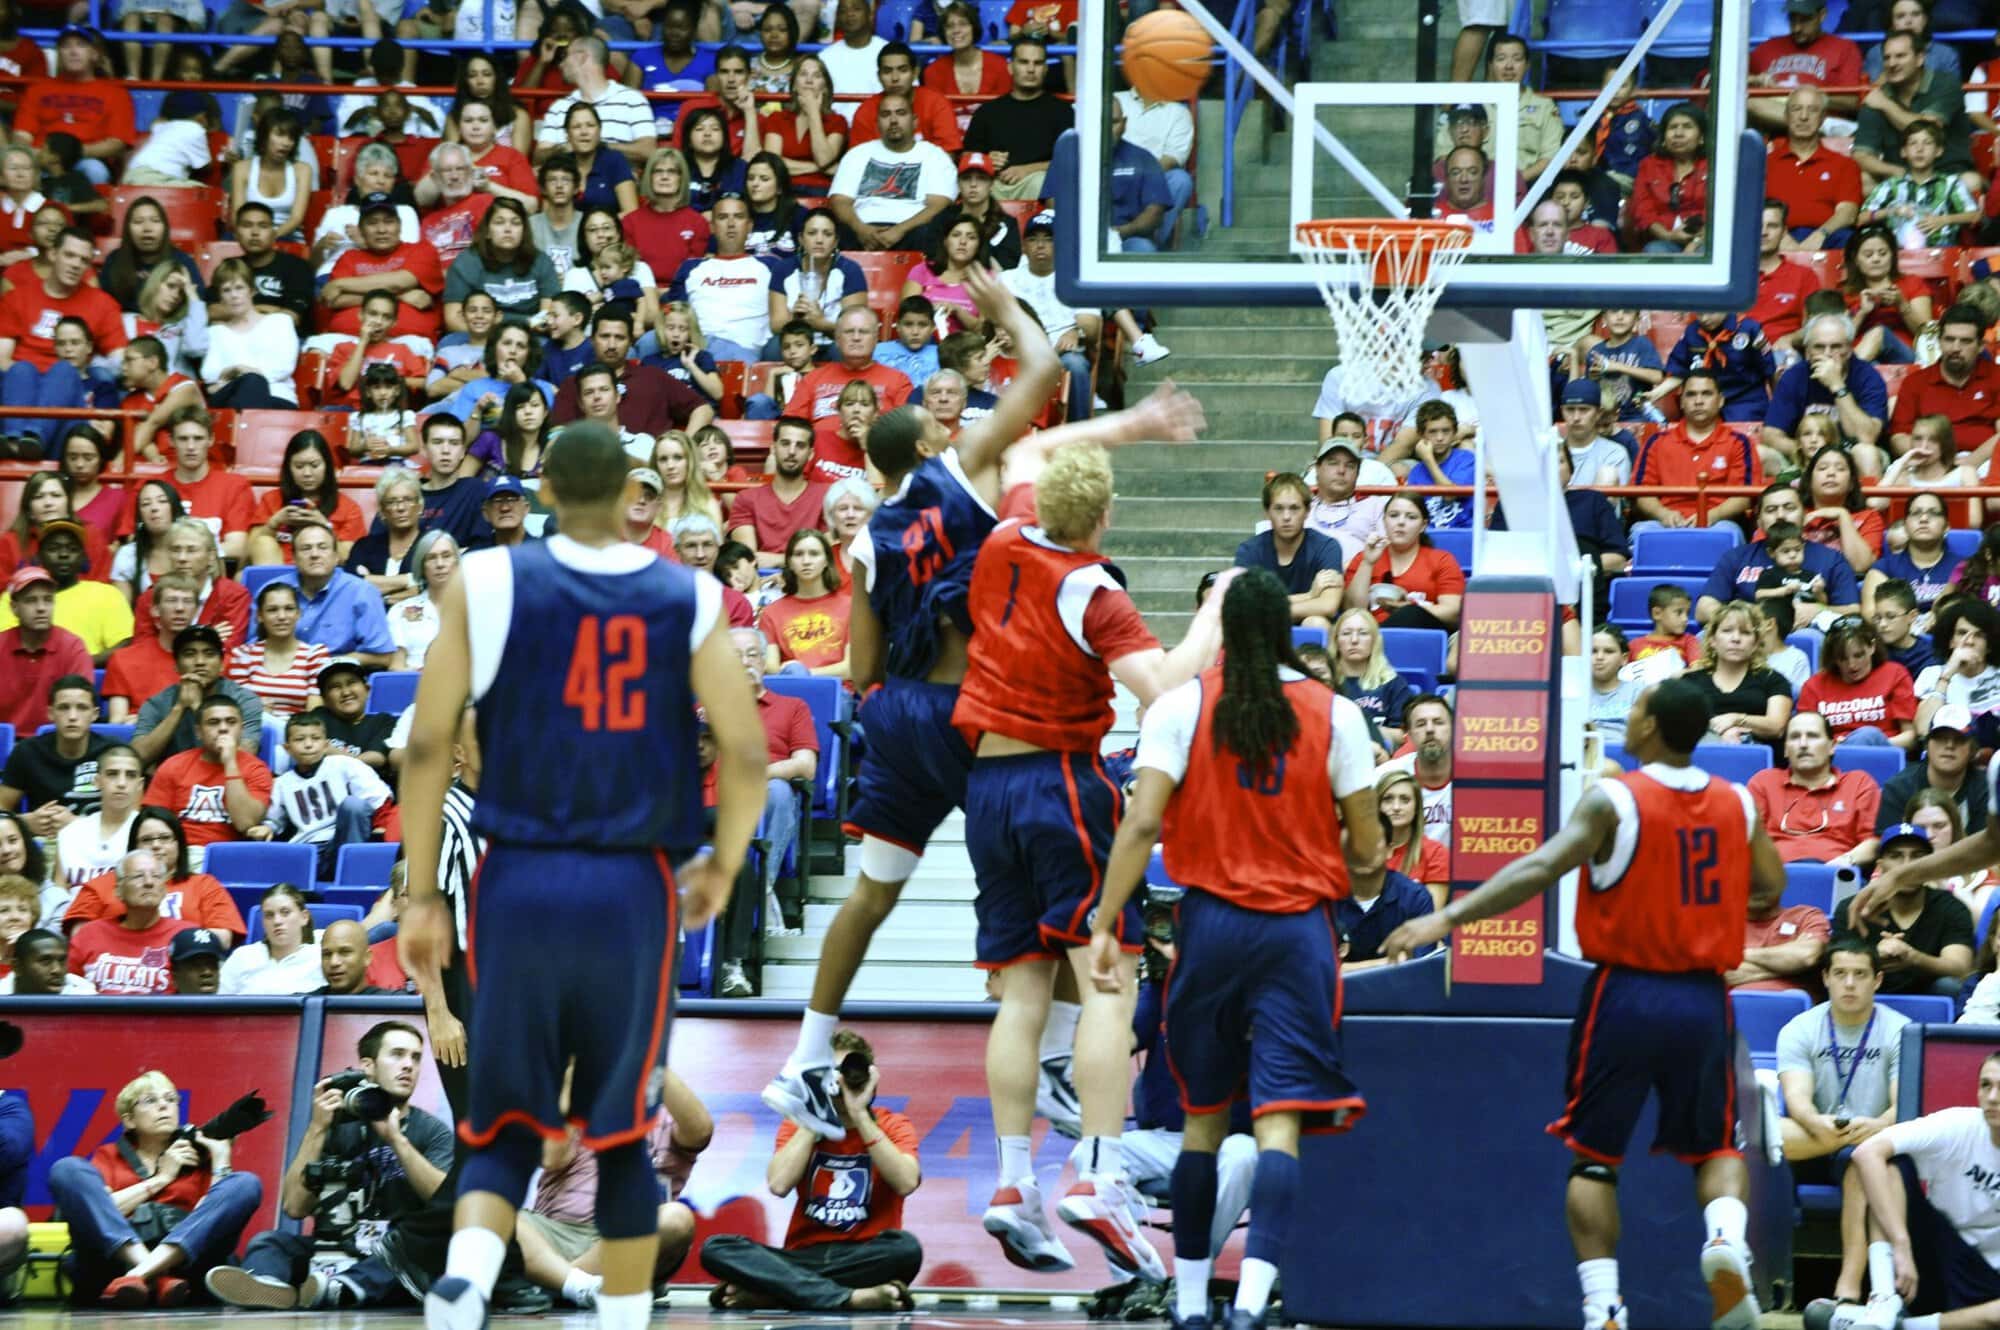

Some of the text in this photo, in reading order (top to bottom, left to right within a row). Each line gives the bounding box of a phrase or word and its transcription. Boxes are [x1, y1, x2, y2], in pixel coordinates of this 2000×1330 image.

[1001, 561, 1020, 628] 1
[1468, 620, 1546, 635] WELLS
[1468, 638, 1544, 655] FARGO
[564, 615, 651, 731] 42
[1818, 695, 1885, 715] ARIZONA
[1462, 717, 1540, 733] WELLS
[1462, 736, 1538, 752] FARGO
[294, 780, 336, 825] USA
[1459, 817, 1537, 834] WELLS
[1460, 837, 1536, 854] FARGO
[1676, 828, 1721, 906] 12
[1460, 919, 1537, 936] WELLS
[1460, 939, 1537, 957] FARGO
[804, 1203, 868, 1222] NATION
